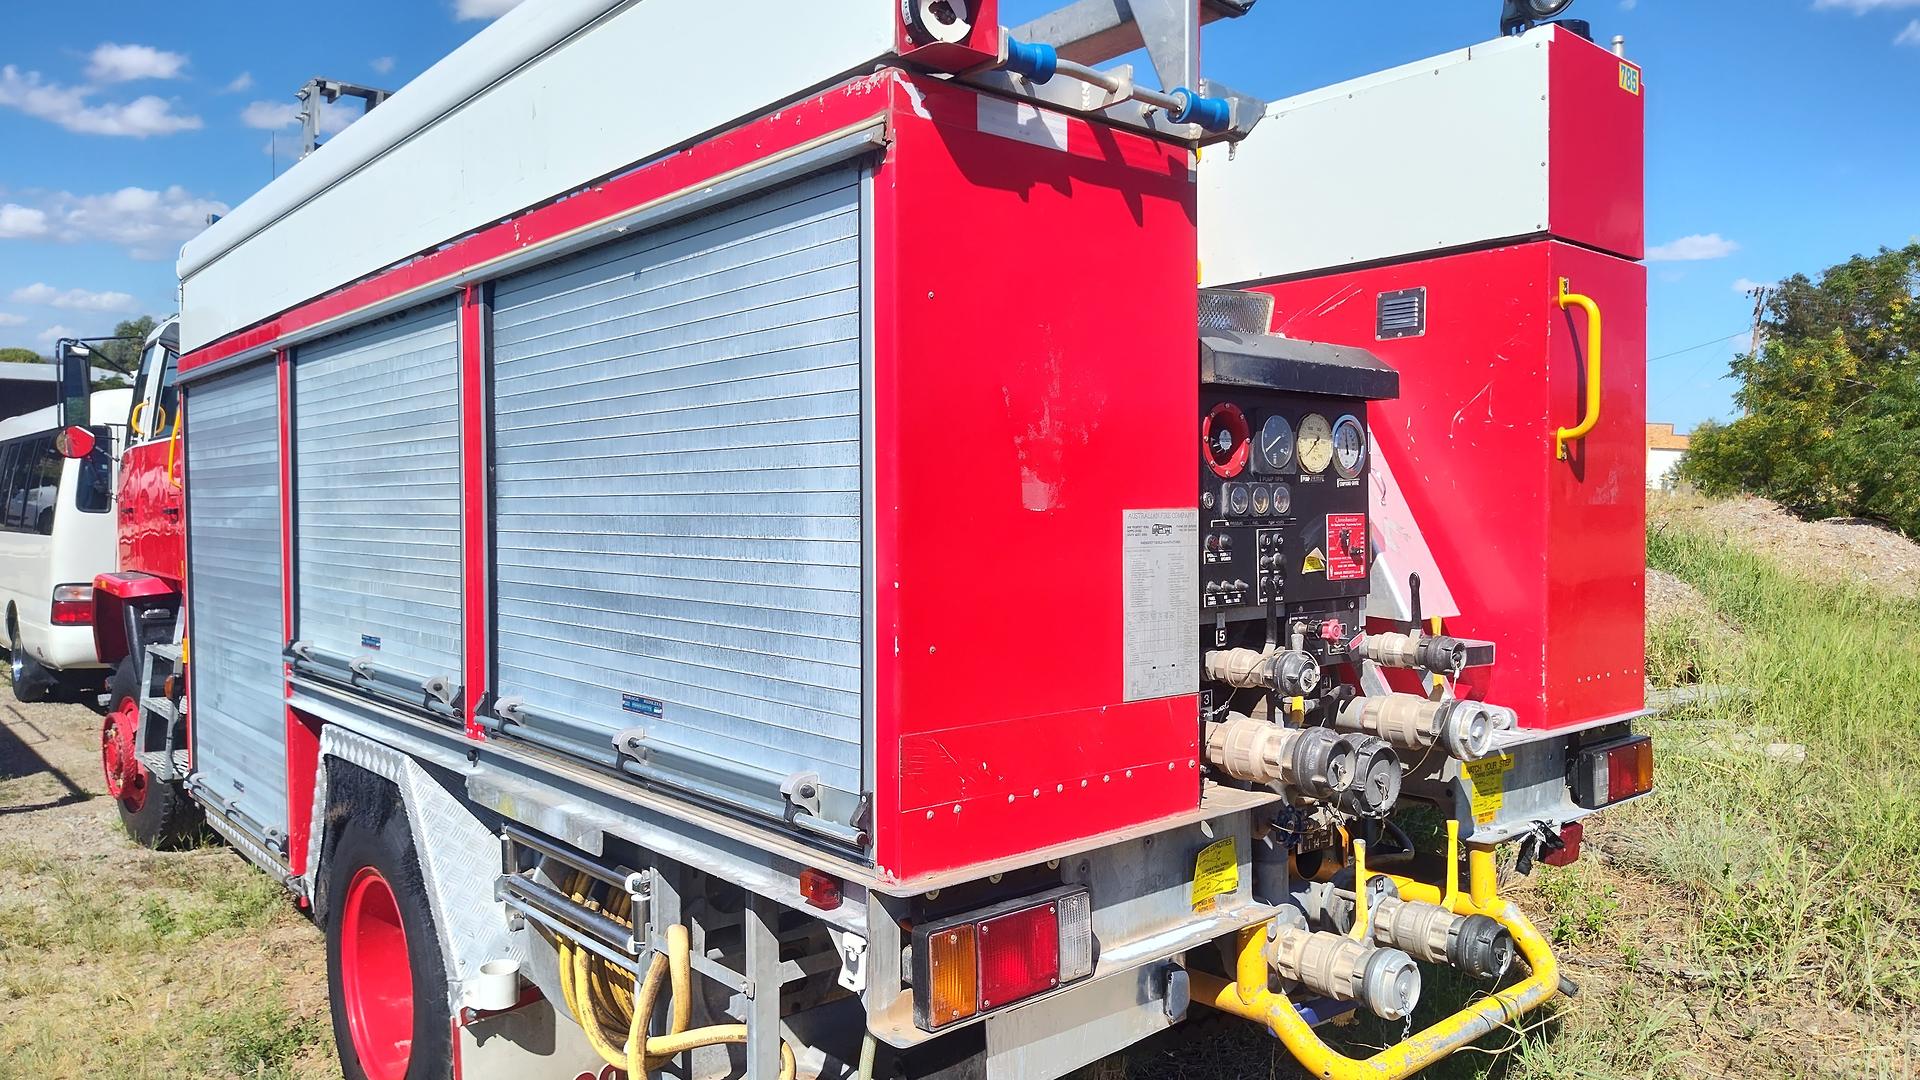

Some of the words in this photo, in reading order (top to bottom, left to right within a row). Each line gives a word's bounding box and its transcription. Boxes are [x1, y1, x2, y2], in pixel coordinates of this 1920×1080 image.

[1621, 65, 1637, 92] 785
[1218, 630, 1226, 642] 5
[1203, 694, 1210, 705] 3
[1484, 761, 1497, 771] YOUR
[1499, 758, 1512, 768] STEP
[1376, 879, 1384, 891] 12
